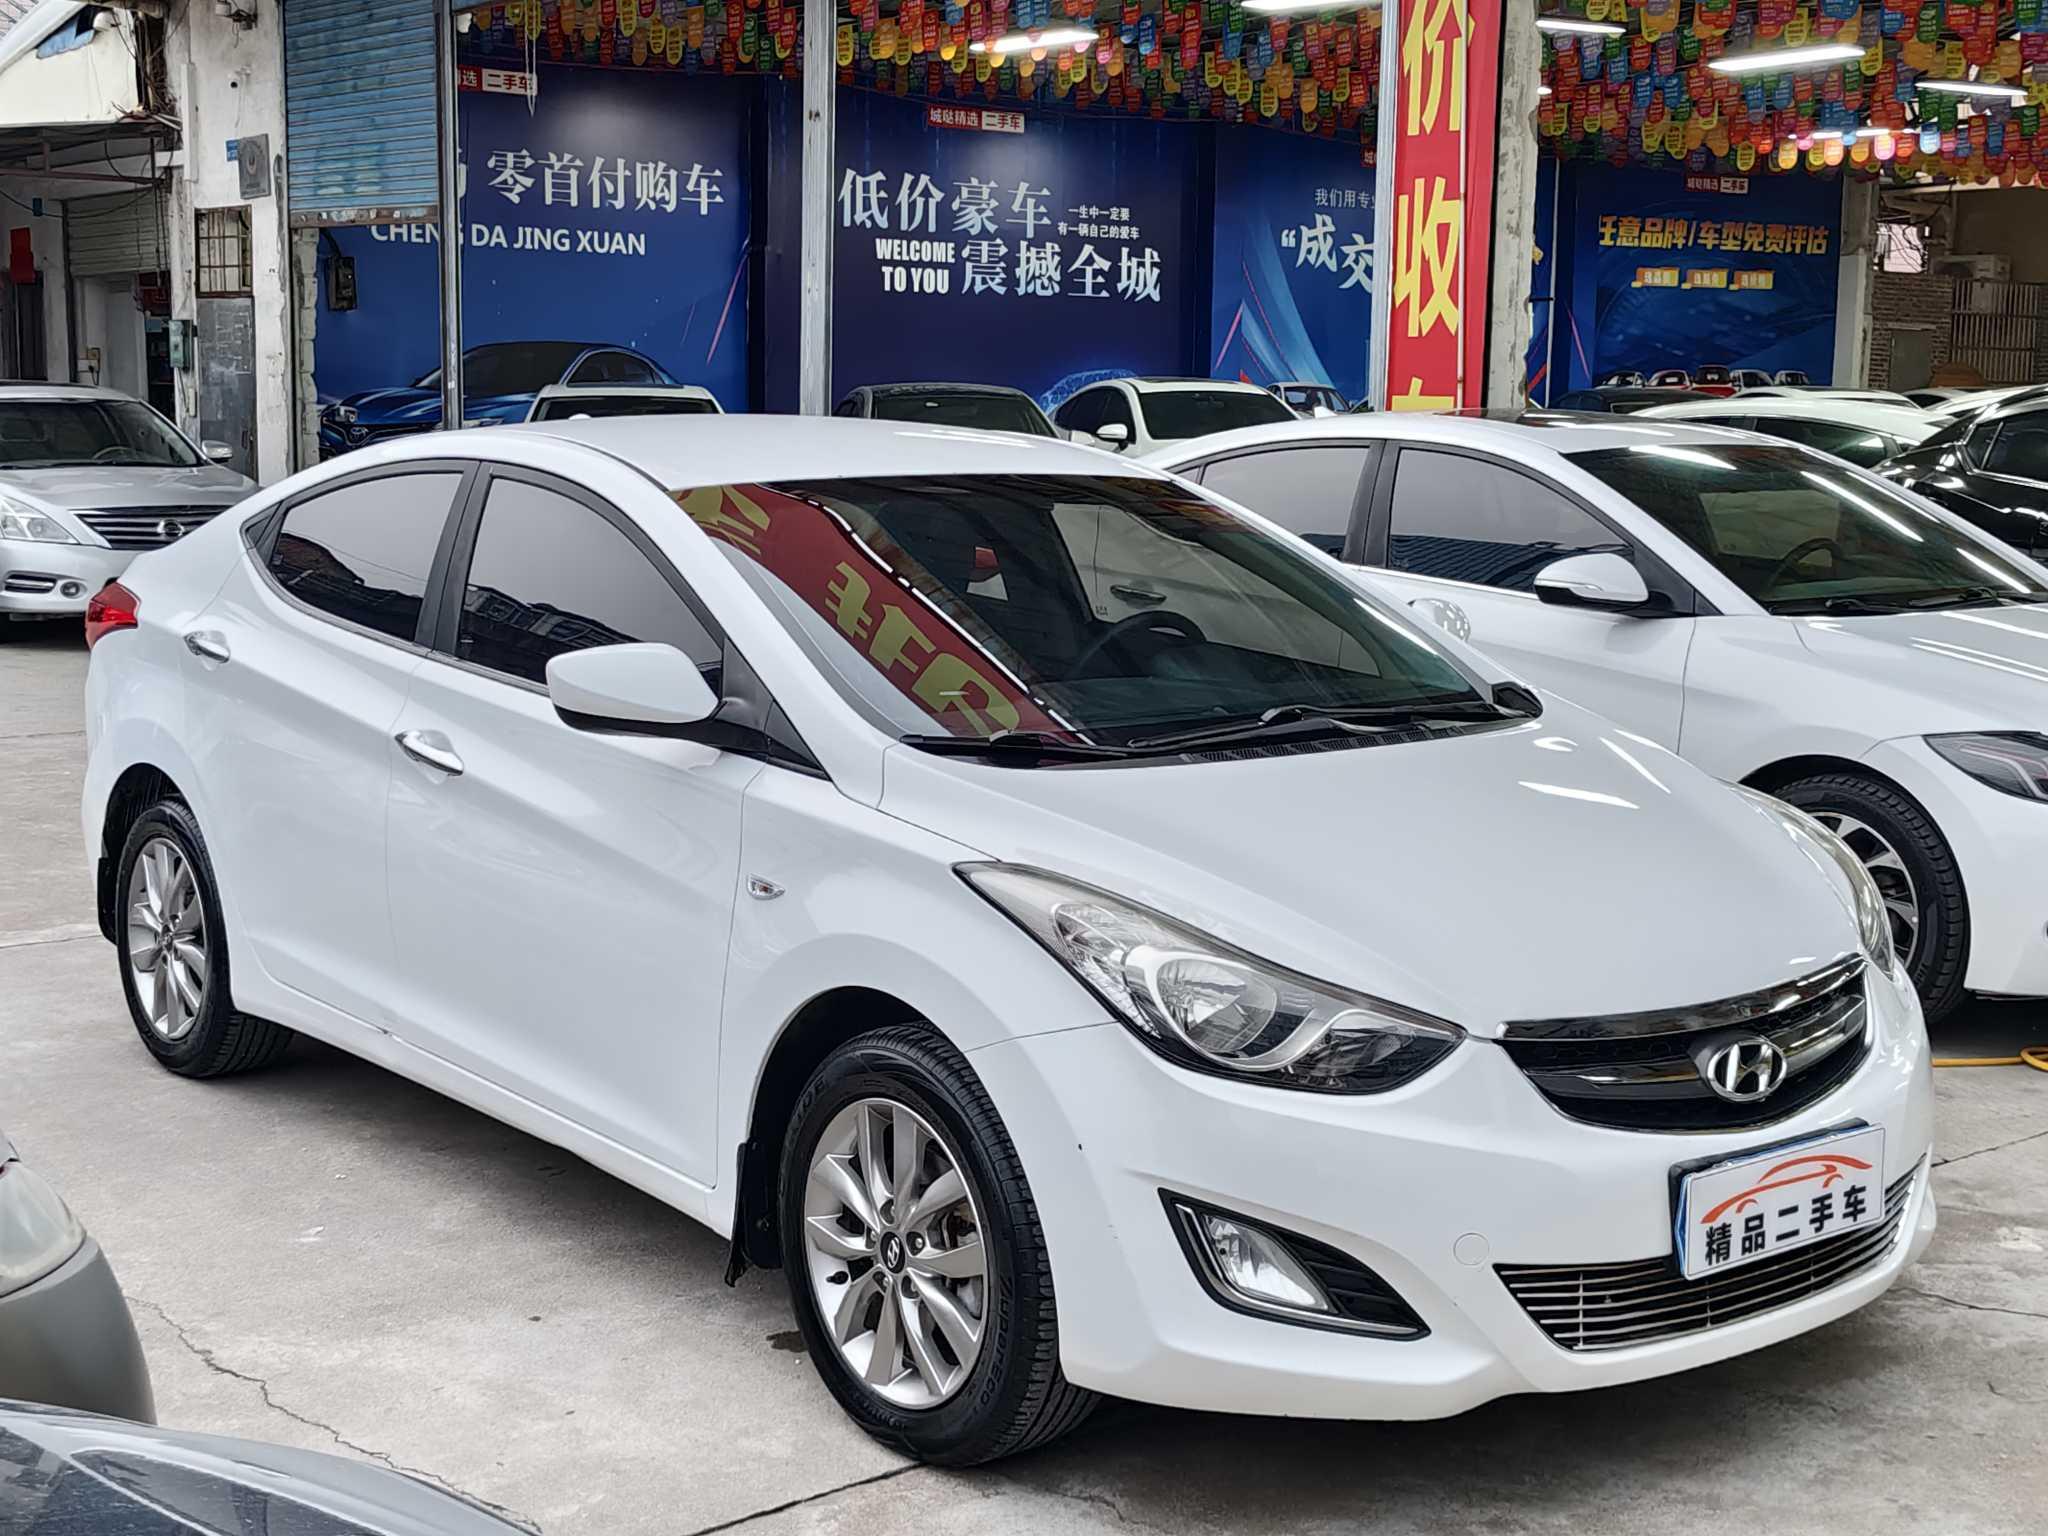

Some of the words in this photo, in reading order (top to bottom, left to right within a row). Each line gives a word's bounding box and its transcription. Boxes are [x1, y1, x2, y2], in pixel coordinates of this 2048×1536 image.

[985, 113, 1021, 130] 二手车
[487, 148, 725, 215] 零首付购车
[839, 167, 1052, 239] 低价豪车
[1068, 204, 1130, 221] 一生中一定要
[471, 223, 508, 249] DA
[513, 226, 571, 252] JING
[577, 230, 645, 256] XUAN
[1057, 221, 1140, 240] 有一辆自己的爱车
[875, 238, 956, 263] WELCOME
[882, 266, 907, 292] TO
[910, 266, 950, 294] YOU
[961, 238, 1161, 302] 震撼全城
[1705, 1184, 1867, 1266] 精品二手车
